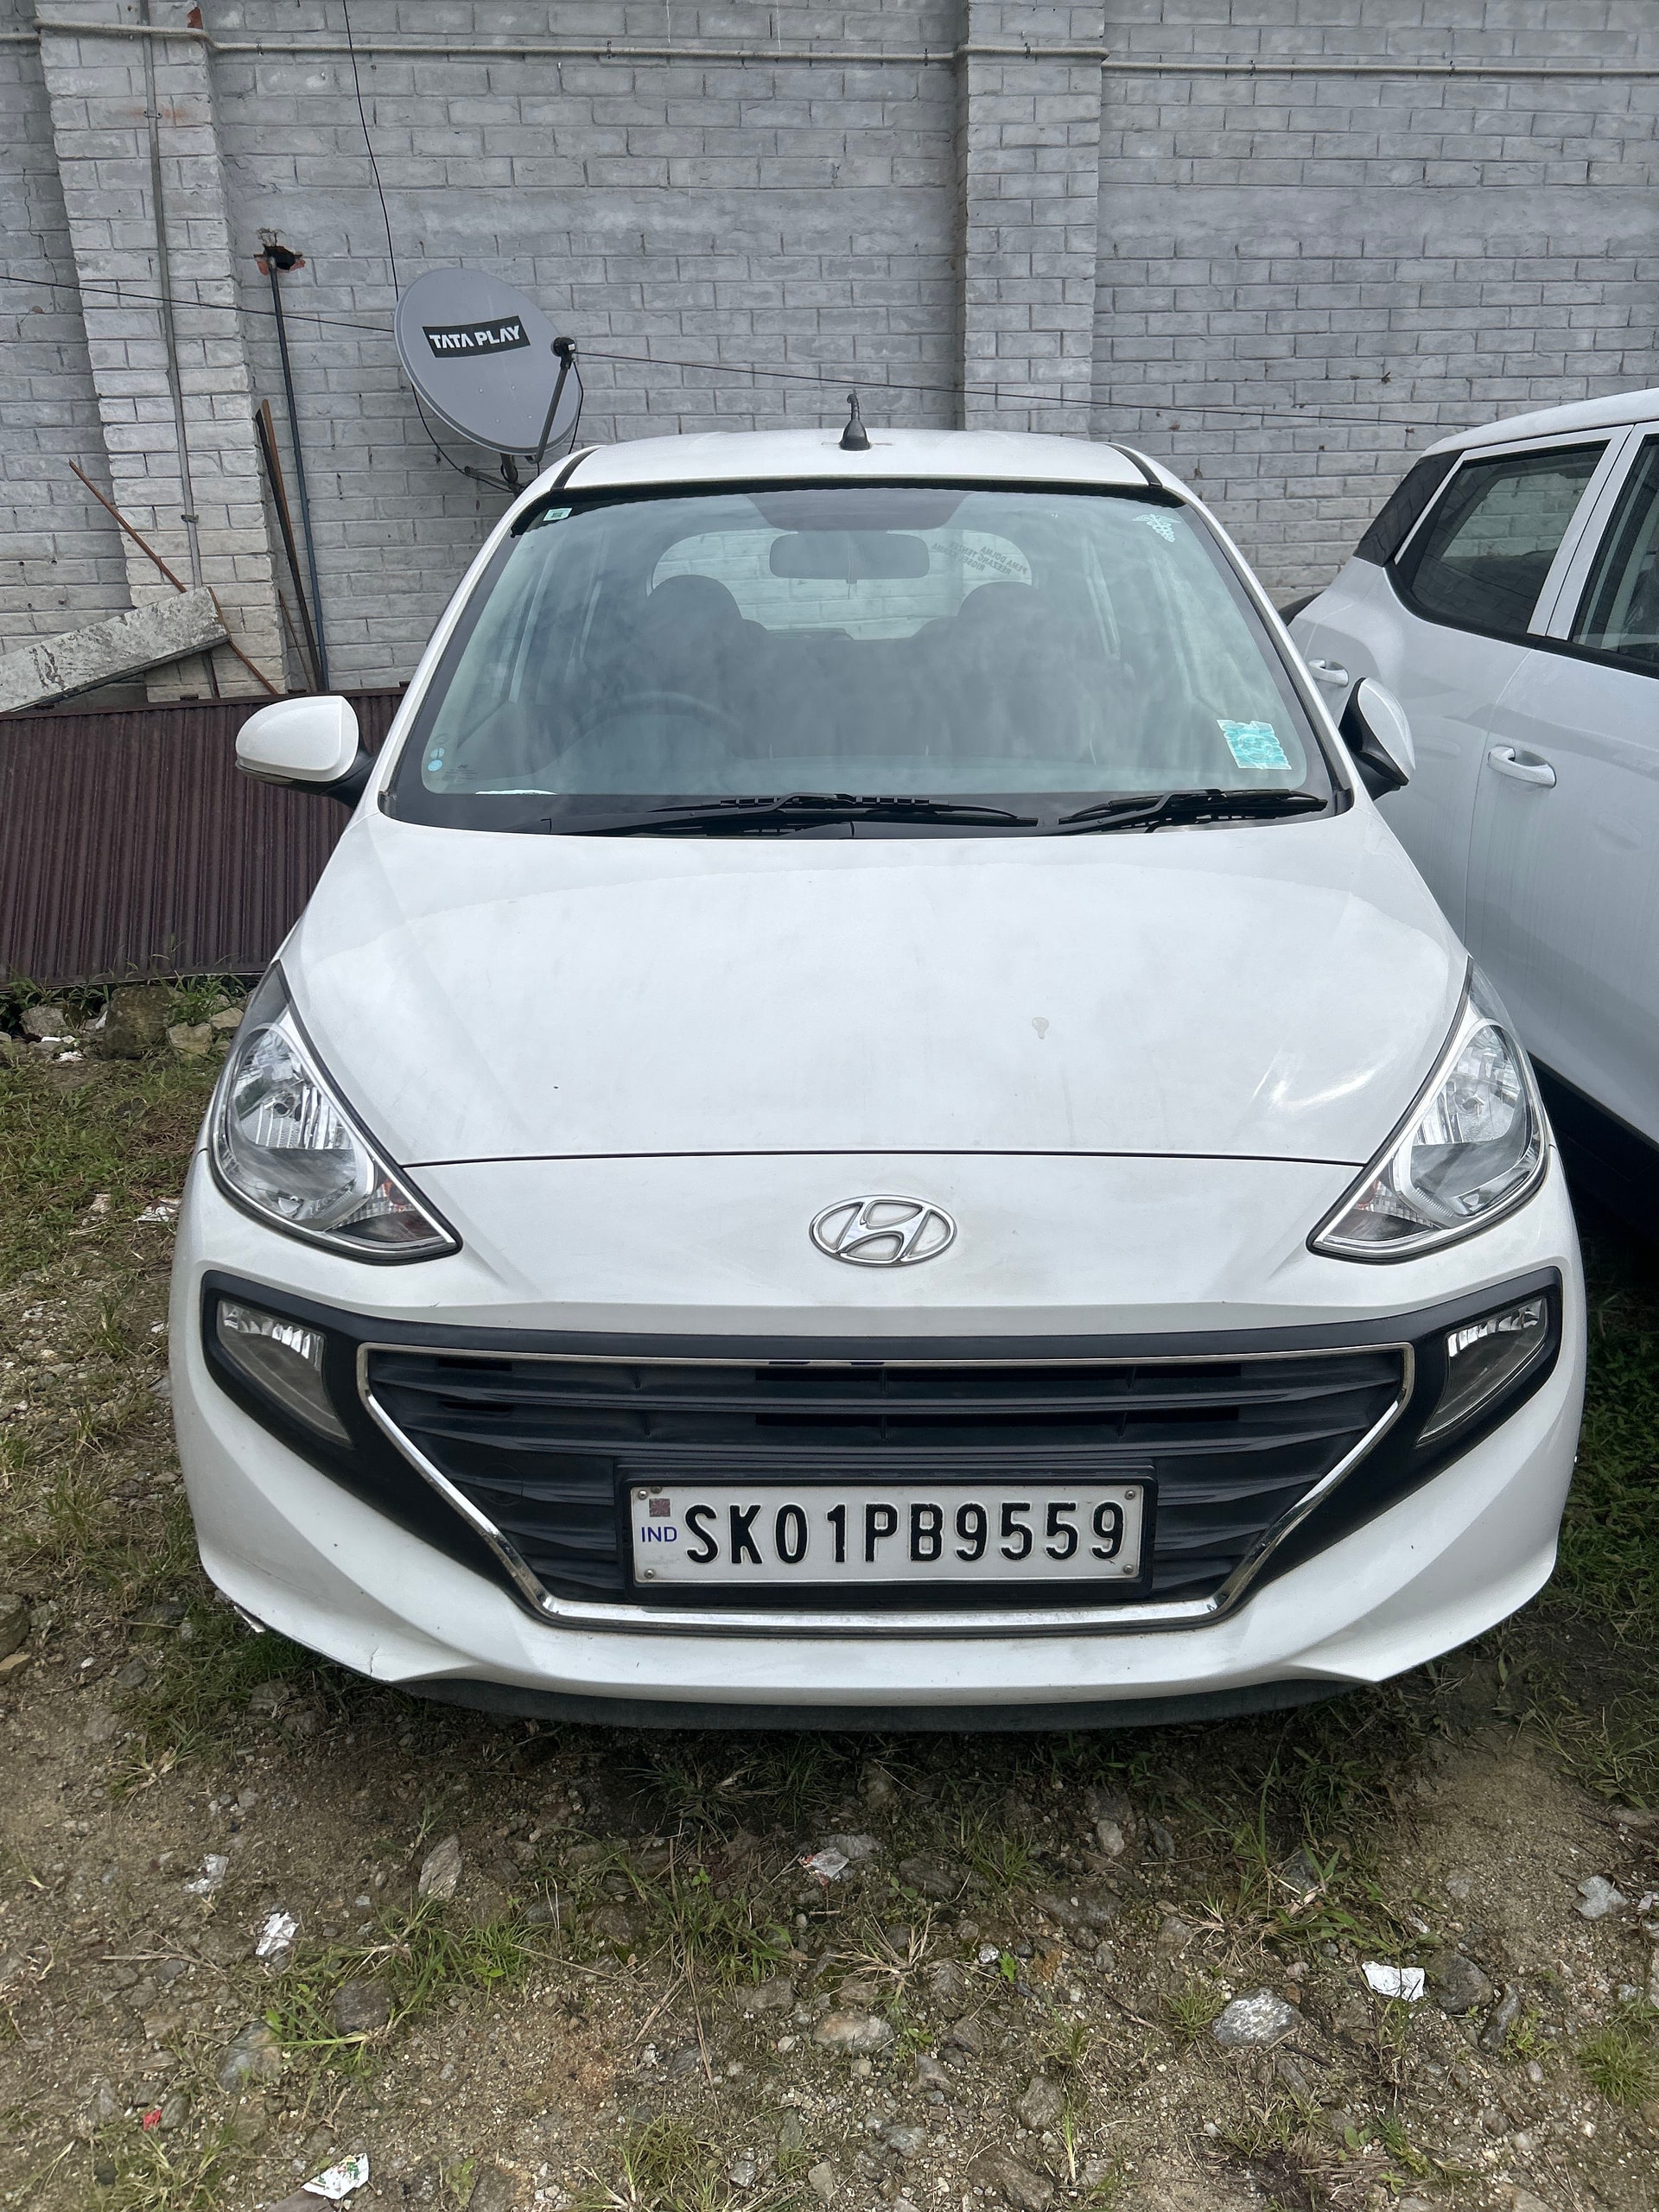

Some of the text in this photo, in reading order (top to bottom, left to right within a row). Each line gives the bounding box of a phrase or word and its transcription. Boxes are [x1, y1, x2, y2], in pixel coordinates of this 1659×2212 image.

[429, 325, 520, 349] TATA PLAY
[640, 1526, 677, 1542] IND
[684, 1502, 1125, 1564] SK01PB9559
